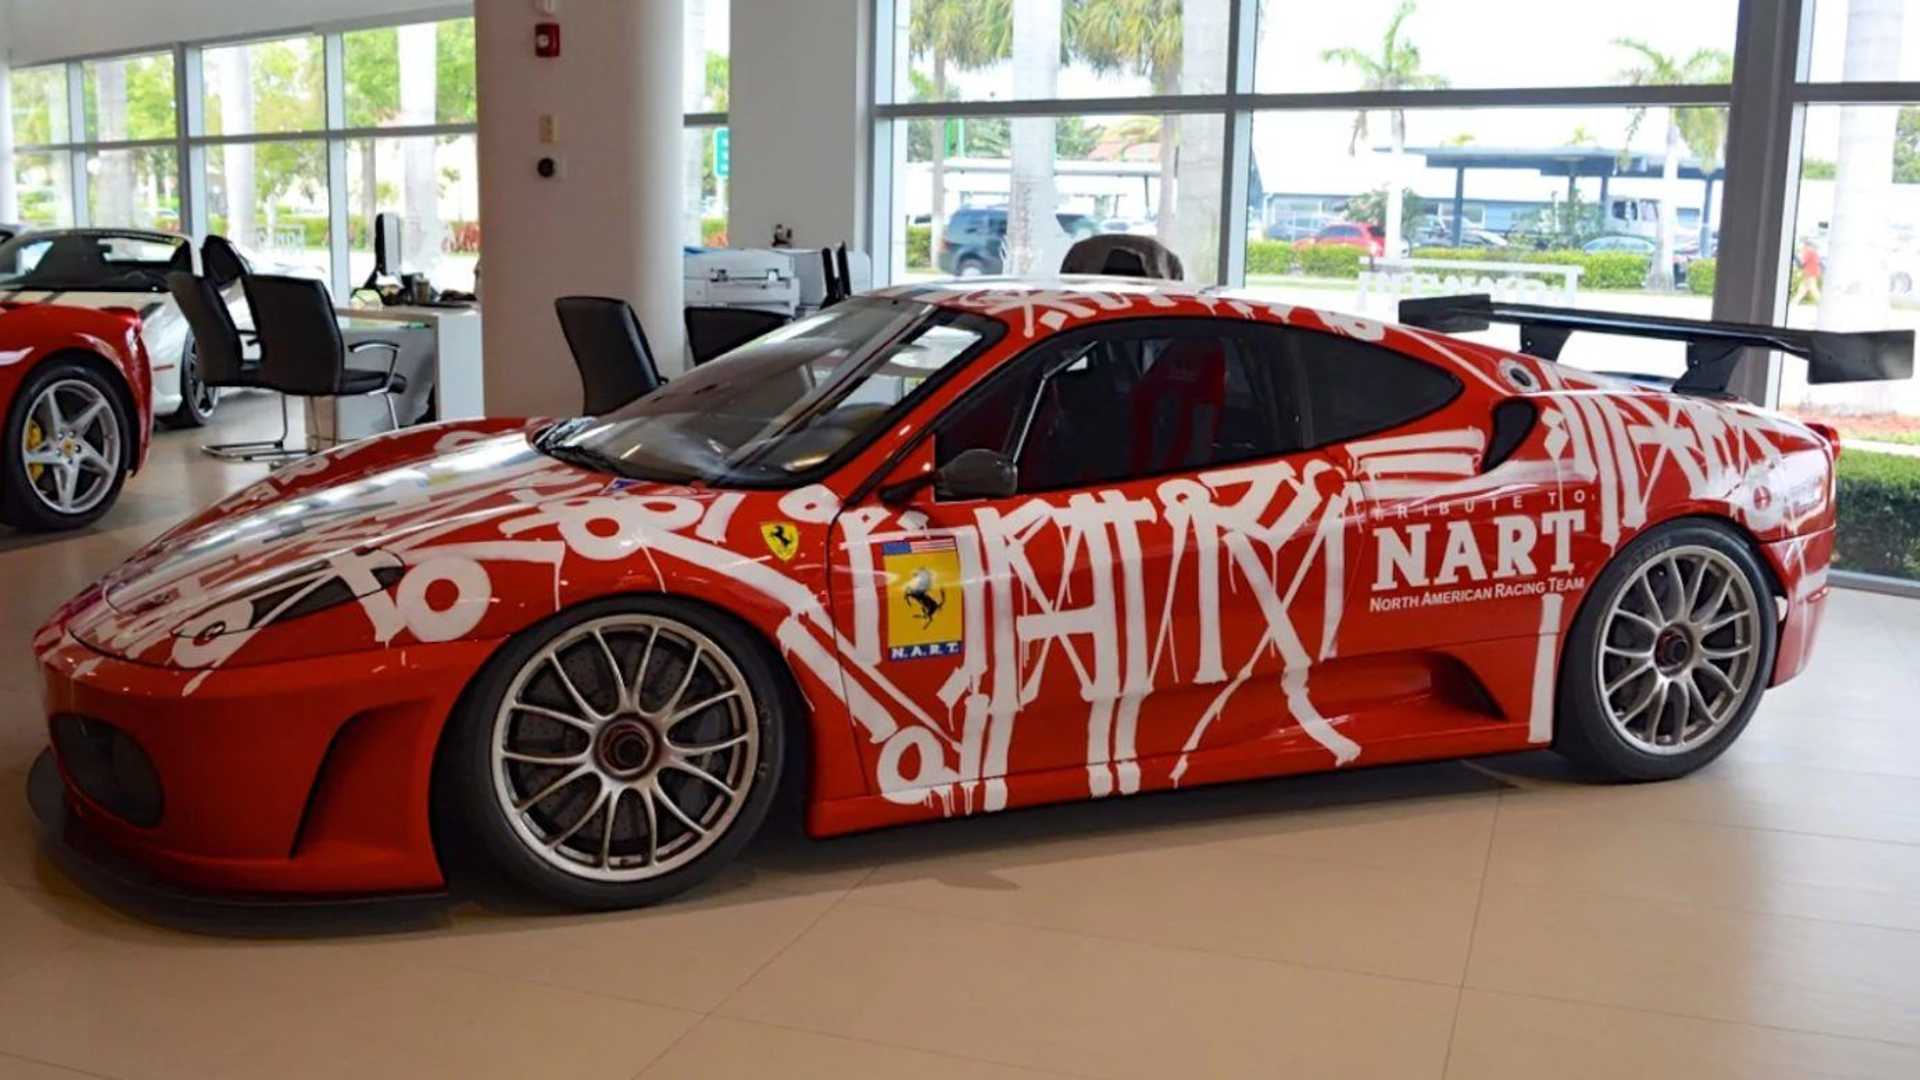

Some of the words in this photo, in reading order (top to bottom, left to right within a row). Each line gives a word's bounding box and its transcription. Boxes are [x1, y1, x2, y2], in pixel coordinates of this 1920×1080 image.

[1548, 489, 1586, 505] TO
[1371, 509, 1585, 591] NART
[1369, 596, 1421, 613] NORTH
[1421, 588, 1493, 606] AMERICAN
[1494, 580, 1546, 599] RACING
[1548, 577, 1585, 593] TEAM
